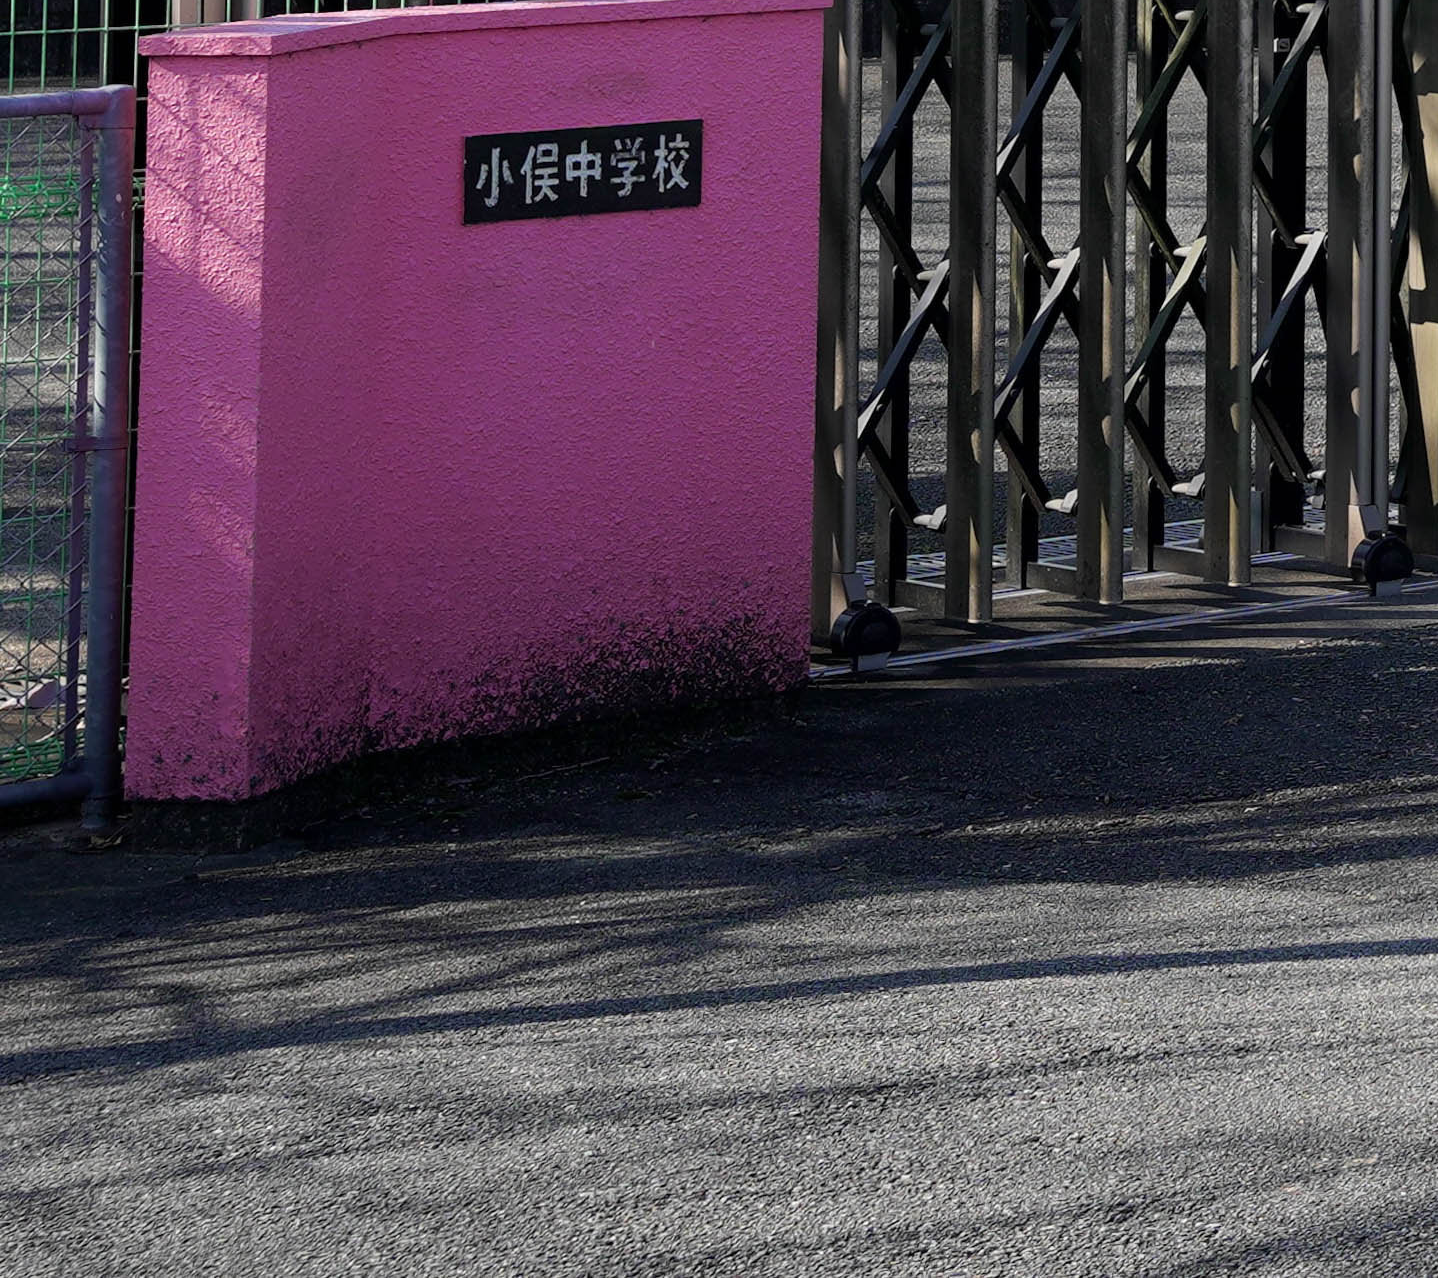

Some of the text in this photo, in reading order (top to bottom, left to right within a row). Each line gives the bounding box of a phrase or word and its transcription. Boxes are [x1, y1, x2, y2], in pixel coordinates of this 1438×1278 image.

[475, 133, 690, 208] 小俣中学校
